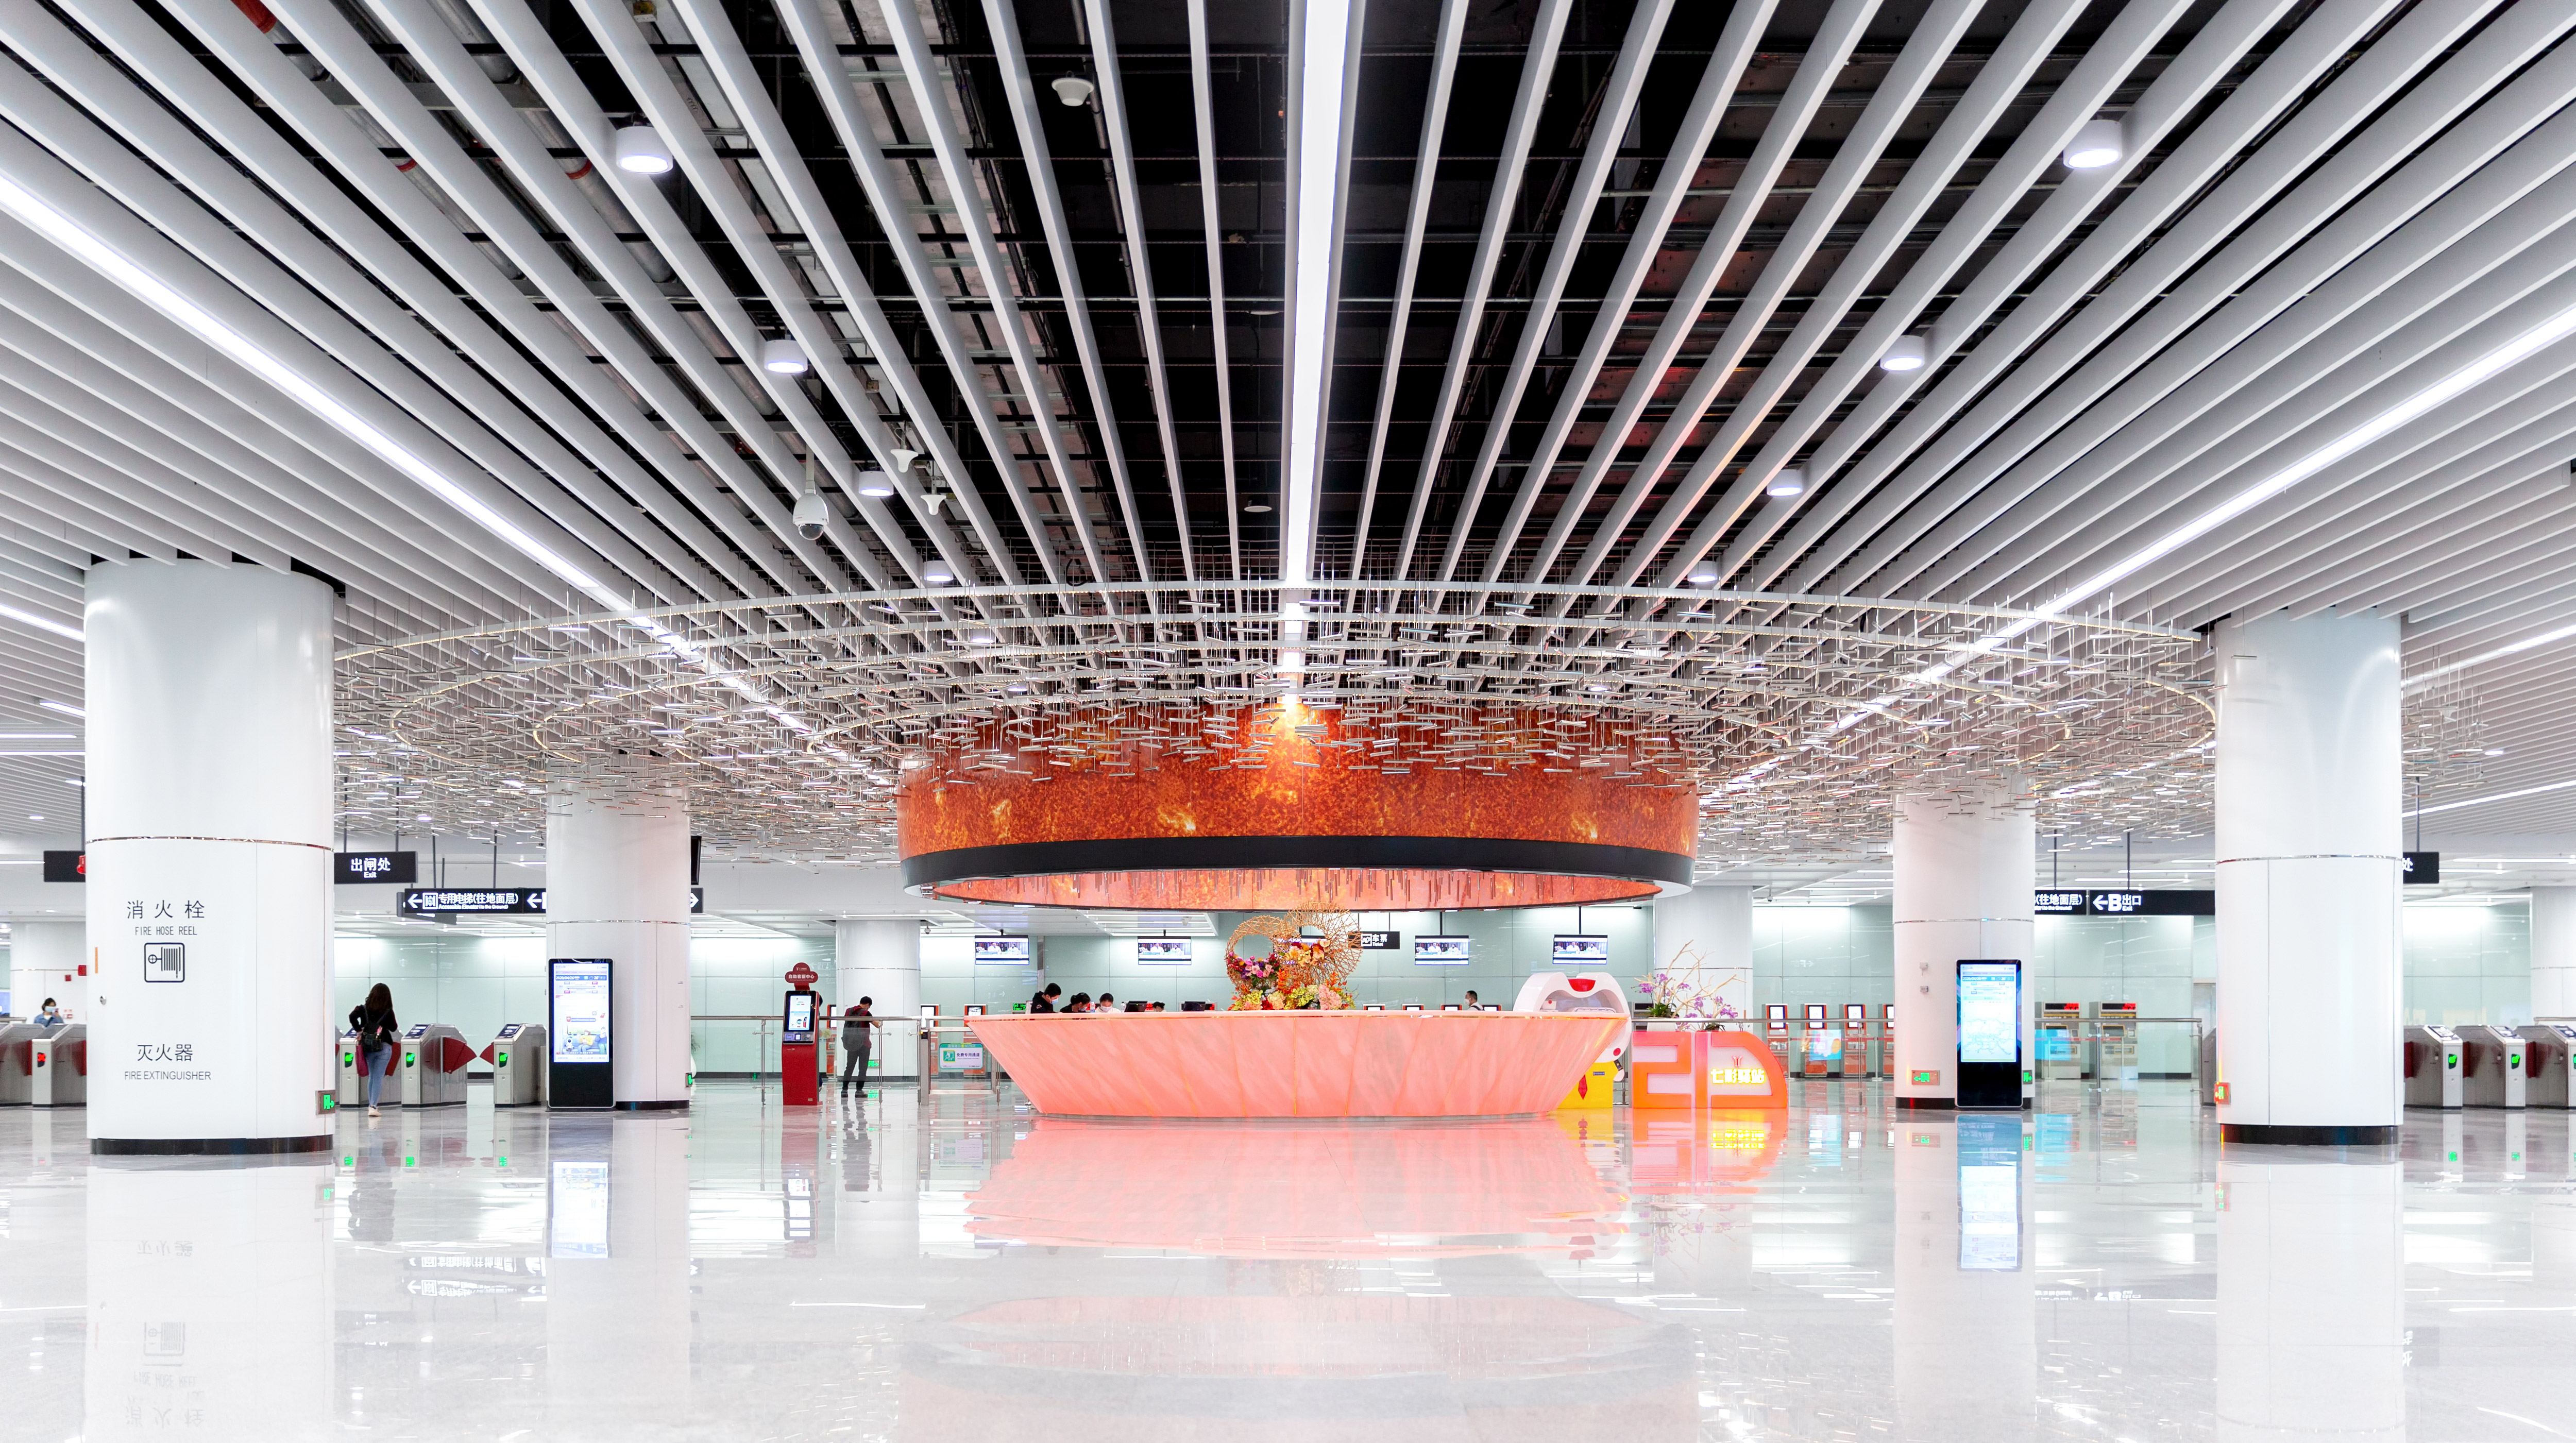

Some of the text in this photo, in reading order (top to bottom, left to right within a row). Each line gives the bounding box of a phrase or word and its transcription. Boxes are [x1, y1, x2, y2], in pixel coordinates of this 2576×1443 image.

[351, 857, 391, 872] 出闸处
[2035, 893, 2082, 905] (往地面层)
[2108, 893, 2142, 911] B 出口
[127, 900, 205, 919] 消火栓
[135, 926, 197, 936] FIRE HOSE REEL
[1372, 933, 1387, 942] 车票
[137, 1044, 193, 1061] 灭火器
[125, 1071, 211, 1080] FIRE EXTINGUISHER
